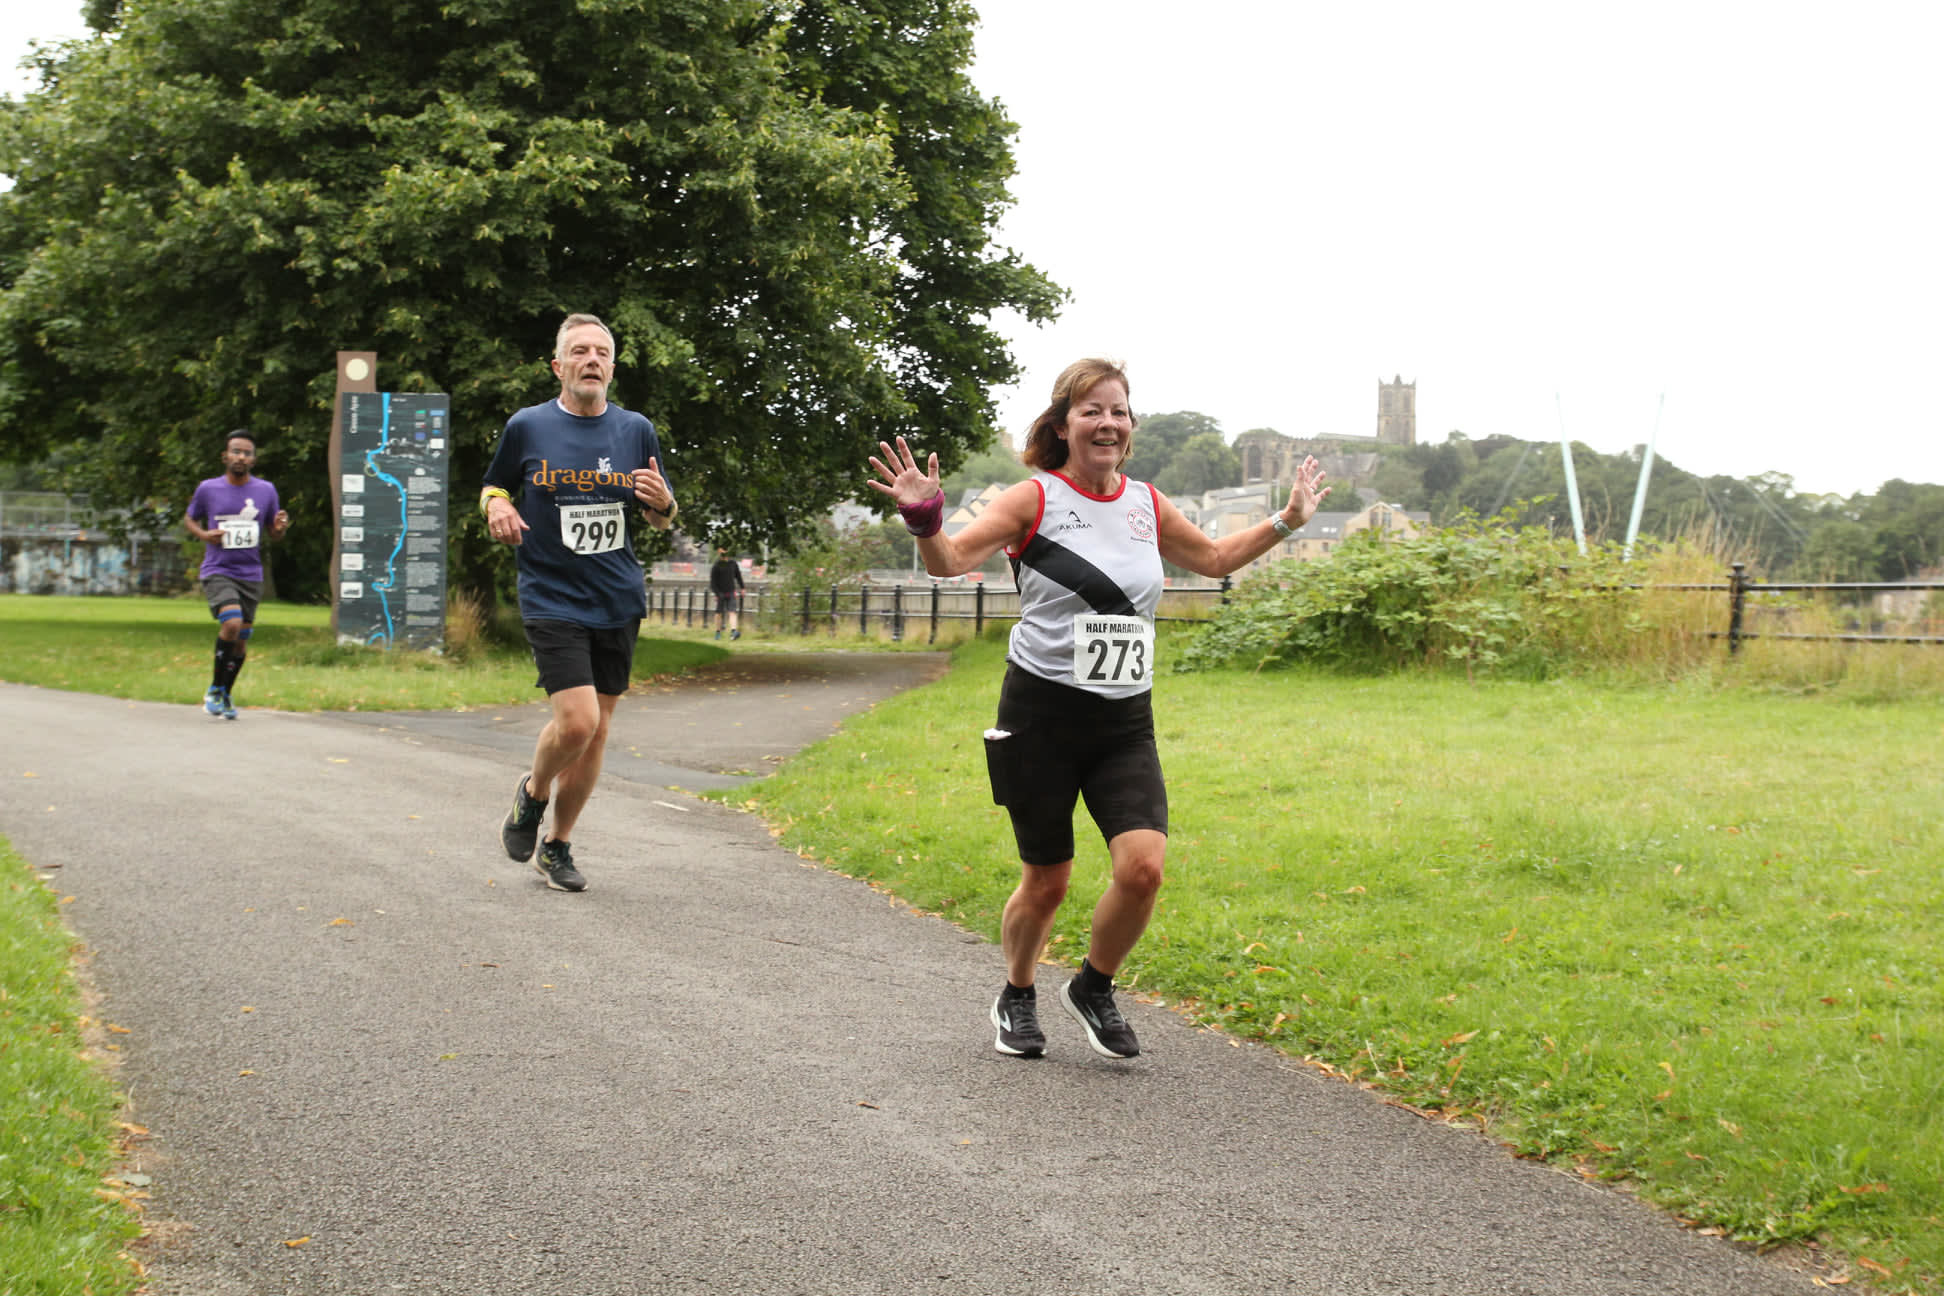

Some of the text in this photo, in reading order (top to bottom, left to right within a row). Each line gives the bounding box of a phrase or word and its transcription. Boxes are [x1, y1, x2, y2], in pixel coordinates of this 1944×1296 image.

[533, 460, 634, 492] dragons
[569, 511, 584, 519] HALF
[1058, 523, 1093, 531] AKUMA
[225, 530, 252, 546] 164
[571, 520, 618, 551] 299
[1086, 623, 1108, 633] HALF
[1087, 638, 1145, 681] 273
